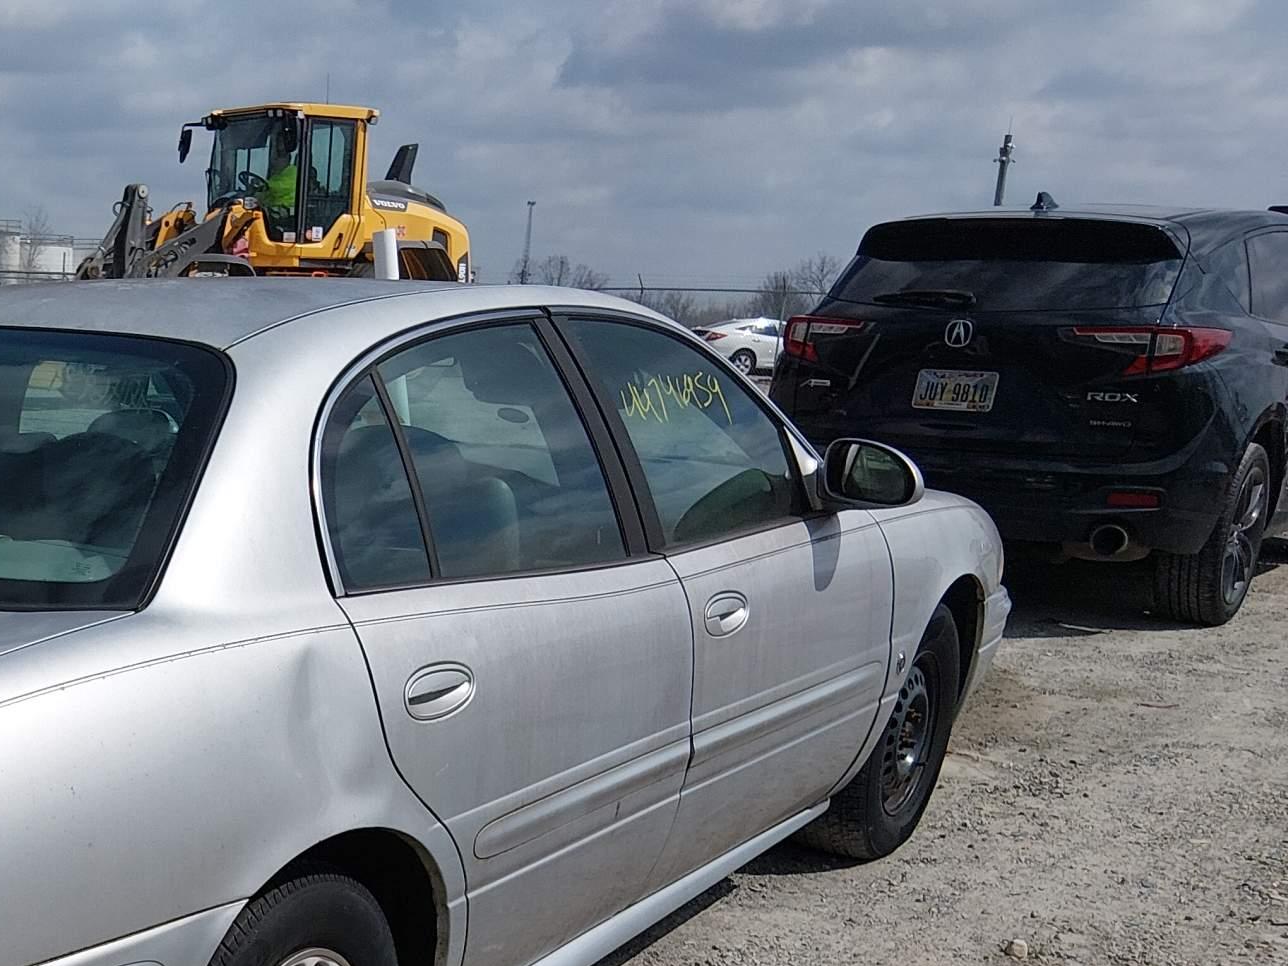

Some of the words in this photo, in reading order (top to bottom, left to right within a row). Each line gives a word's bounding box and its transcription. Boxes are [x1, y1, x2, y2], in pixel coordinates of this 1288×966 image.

[372, 199, 406, 209] VOLVO
[919, 381, 948, 401] JUY
[952, 382, 990, 403] 9810
[1086, 391, 1139, 403] RDX
